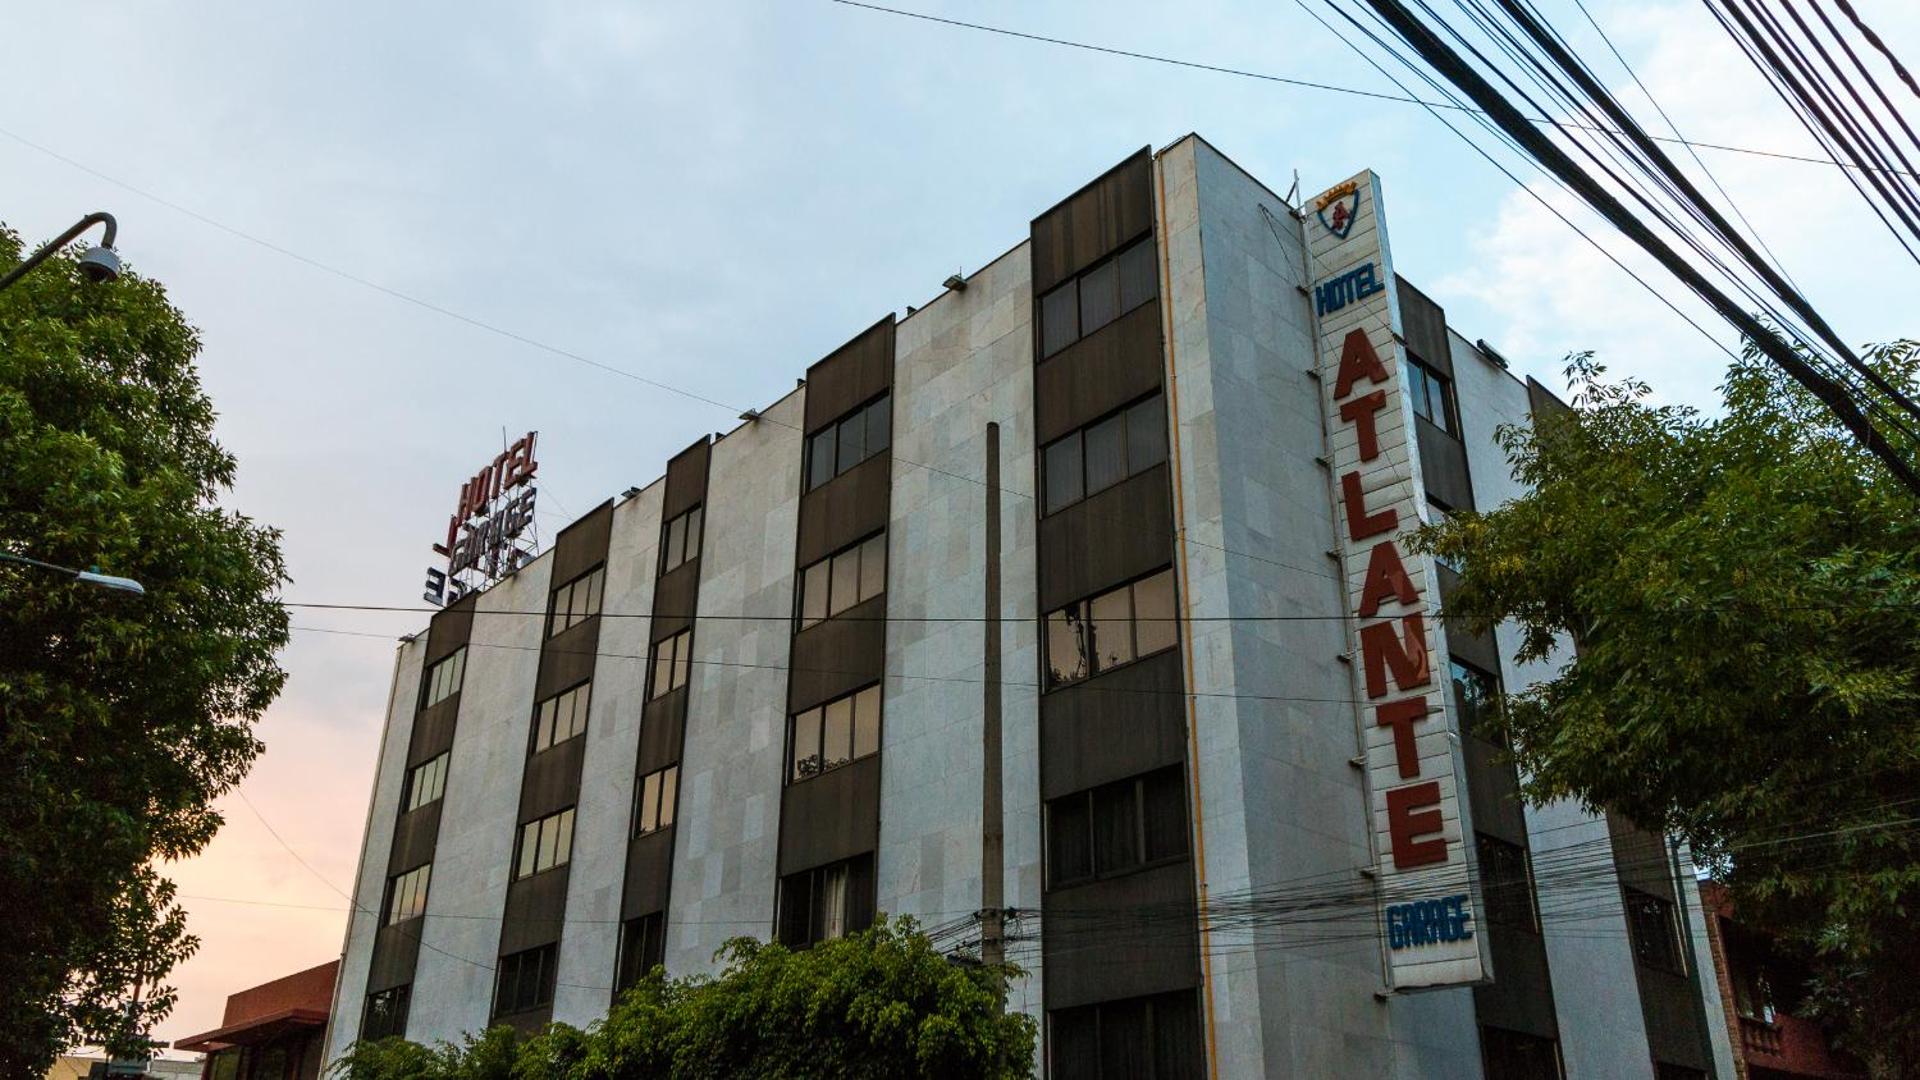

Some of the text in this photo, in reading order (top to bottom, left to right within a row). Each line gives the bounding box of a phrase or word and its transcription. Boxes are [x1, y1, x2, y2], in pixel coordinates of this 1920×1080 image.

[1314, 262, 1386, 318] HOTEL
[457, 431, 539, 527] HOTEL
[1334, 327, 1449, 870] ATLANTE
[1386, 893, 1475, 950] GARAGE
